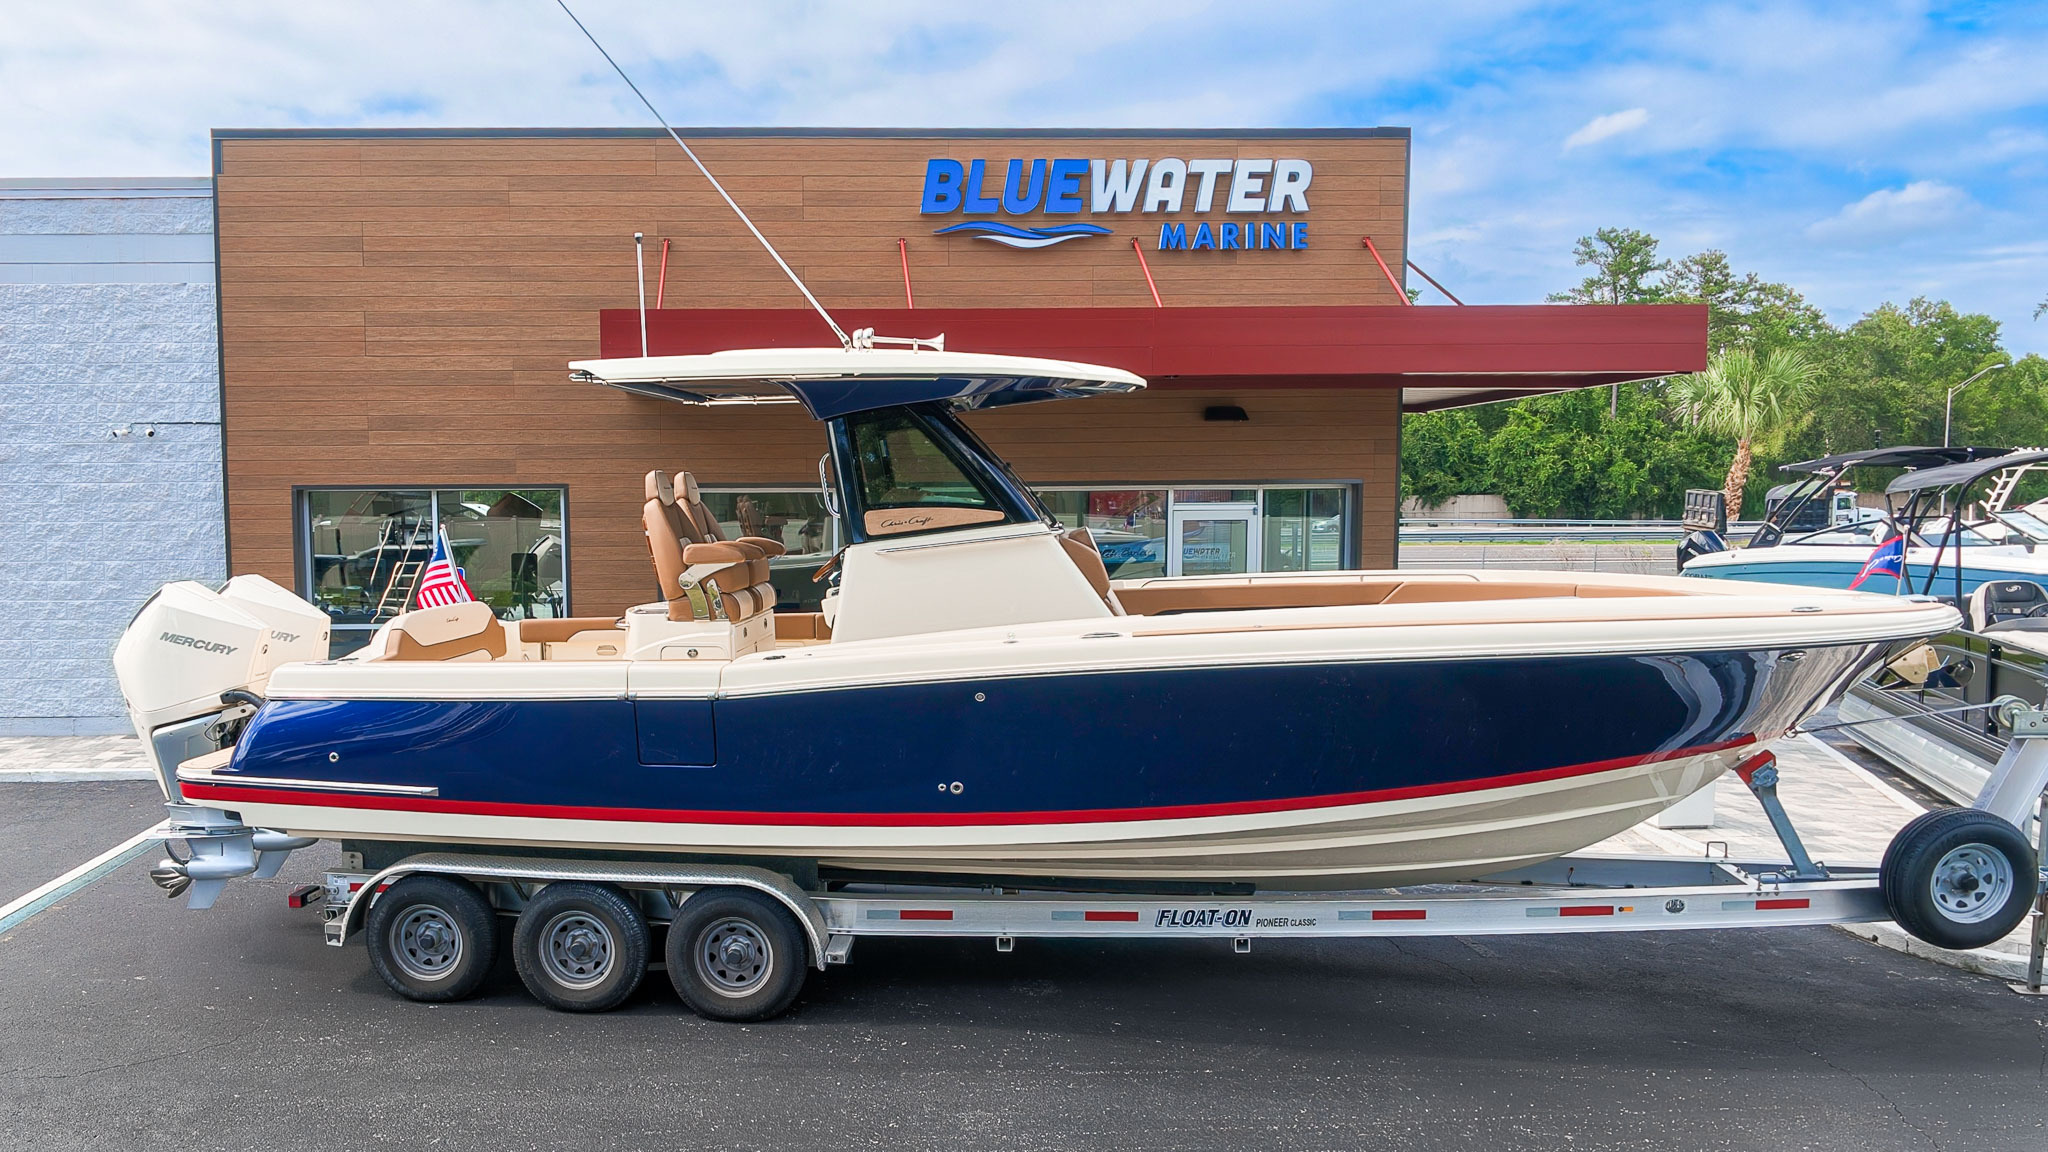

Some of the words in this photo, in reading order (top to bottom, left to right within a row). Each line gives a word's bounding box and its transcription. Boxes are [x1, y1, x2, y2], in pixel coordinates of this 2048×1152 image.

[919, 158, 1313, 215] BLUEWATER
[1158, 222, 1309, 251] MARINE
[159, 631, 238, 656] MERCURY
[1155, 909, 1253, 928] FLOAT-ON
[1256, 917, 1289, 928] PIONEER
[1290, 918, 1317, 927] CLASSIC
